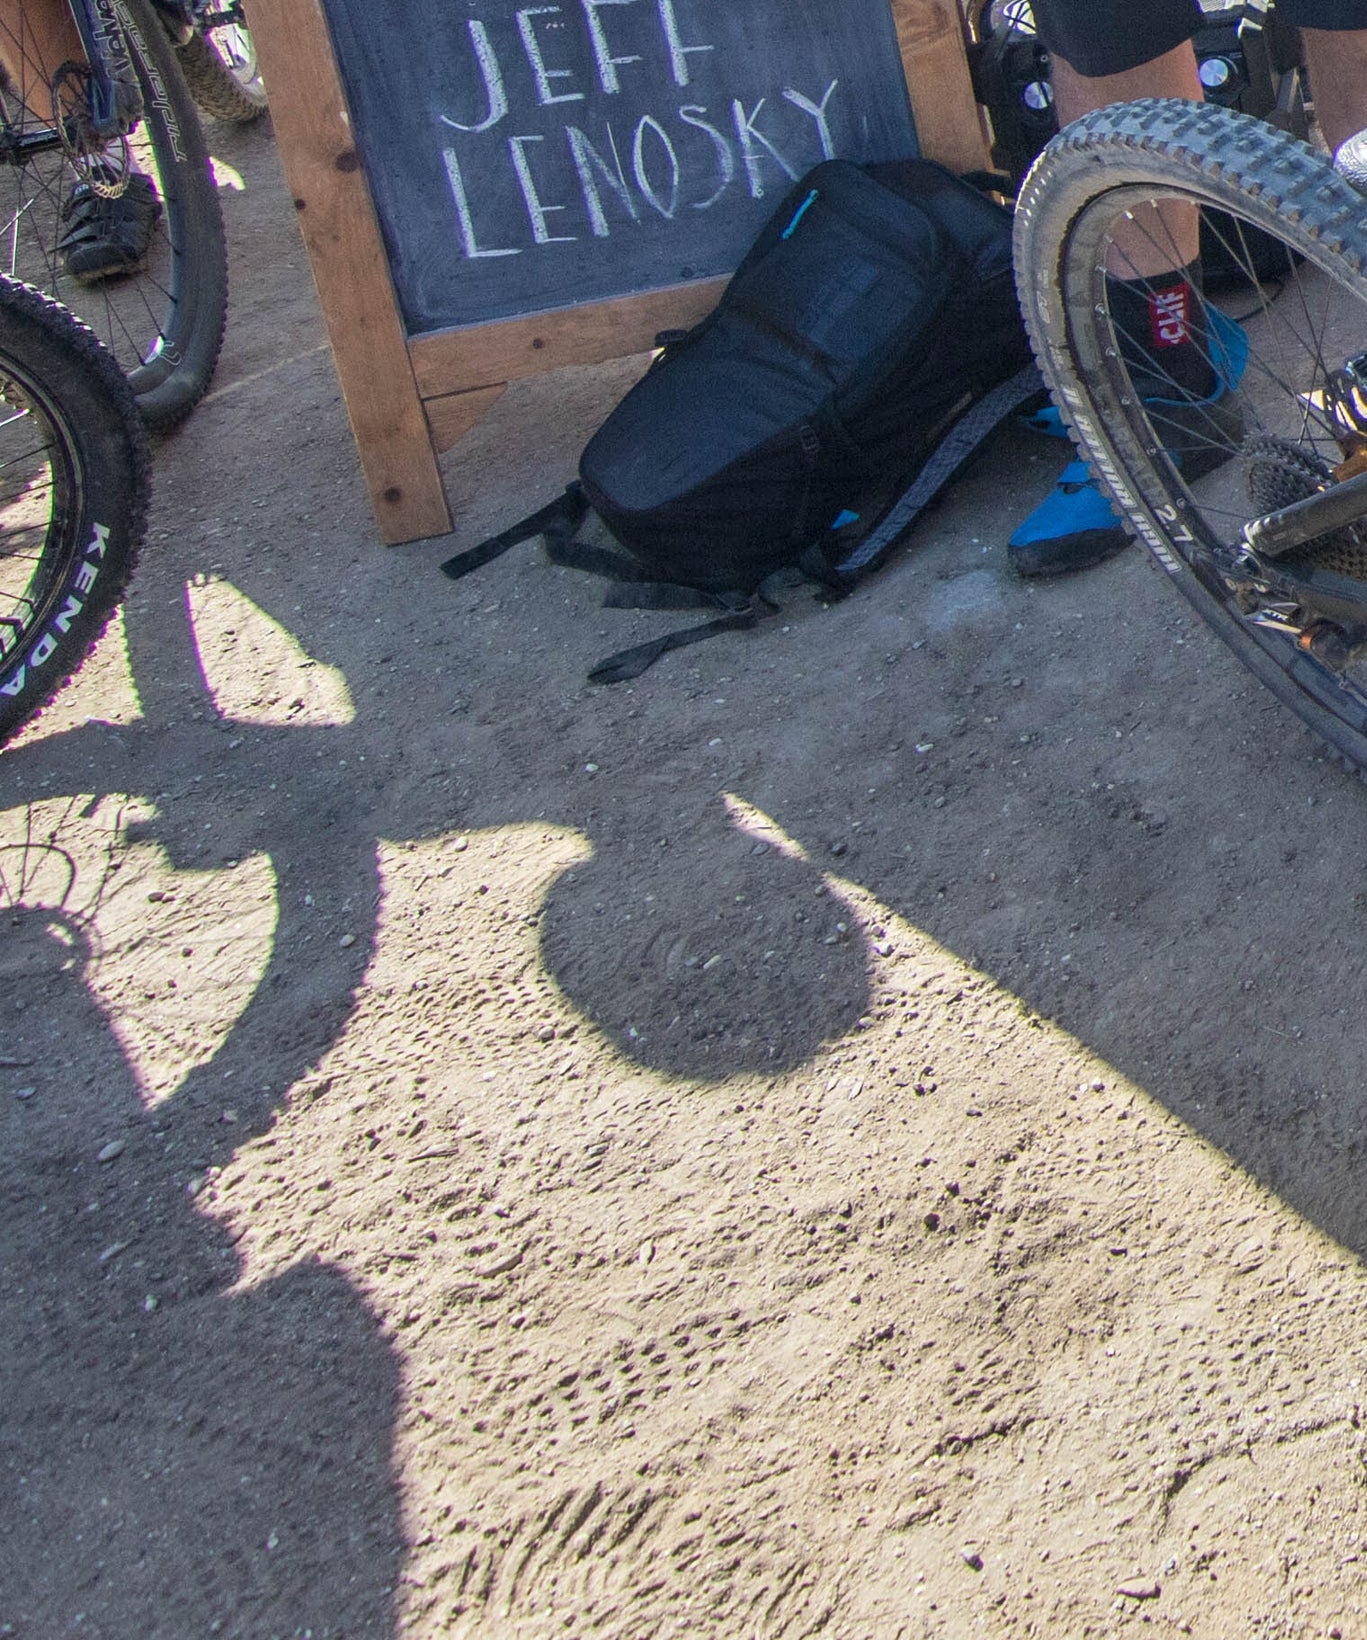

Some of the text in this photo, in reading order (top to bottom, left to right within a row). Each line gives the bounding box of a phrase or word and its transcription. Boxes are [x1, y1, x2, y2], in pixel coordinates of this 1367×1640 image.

[441, 78, 840, 260] LENOSKY
[0, 520, 112, 698] KENDA
[1154, 503, 1195, 545] 2.7
